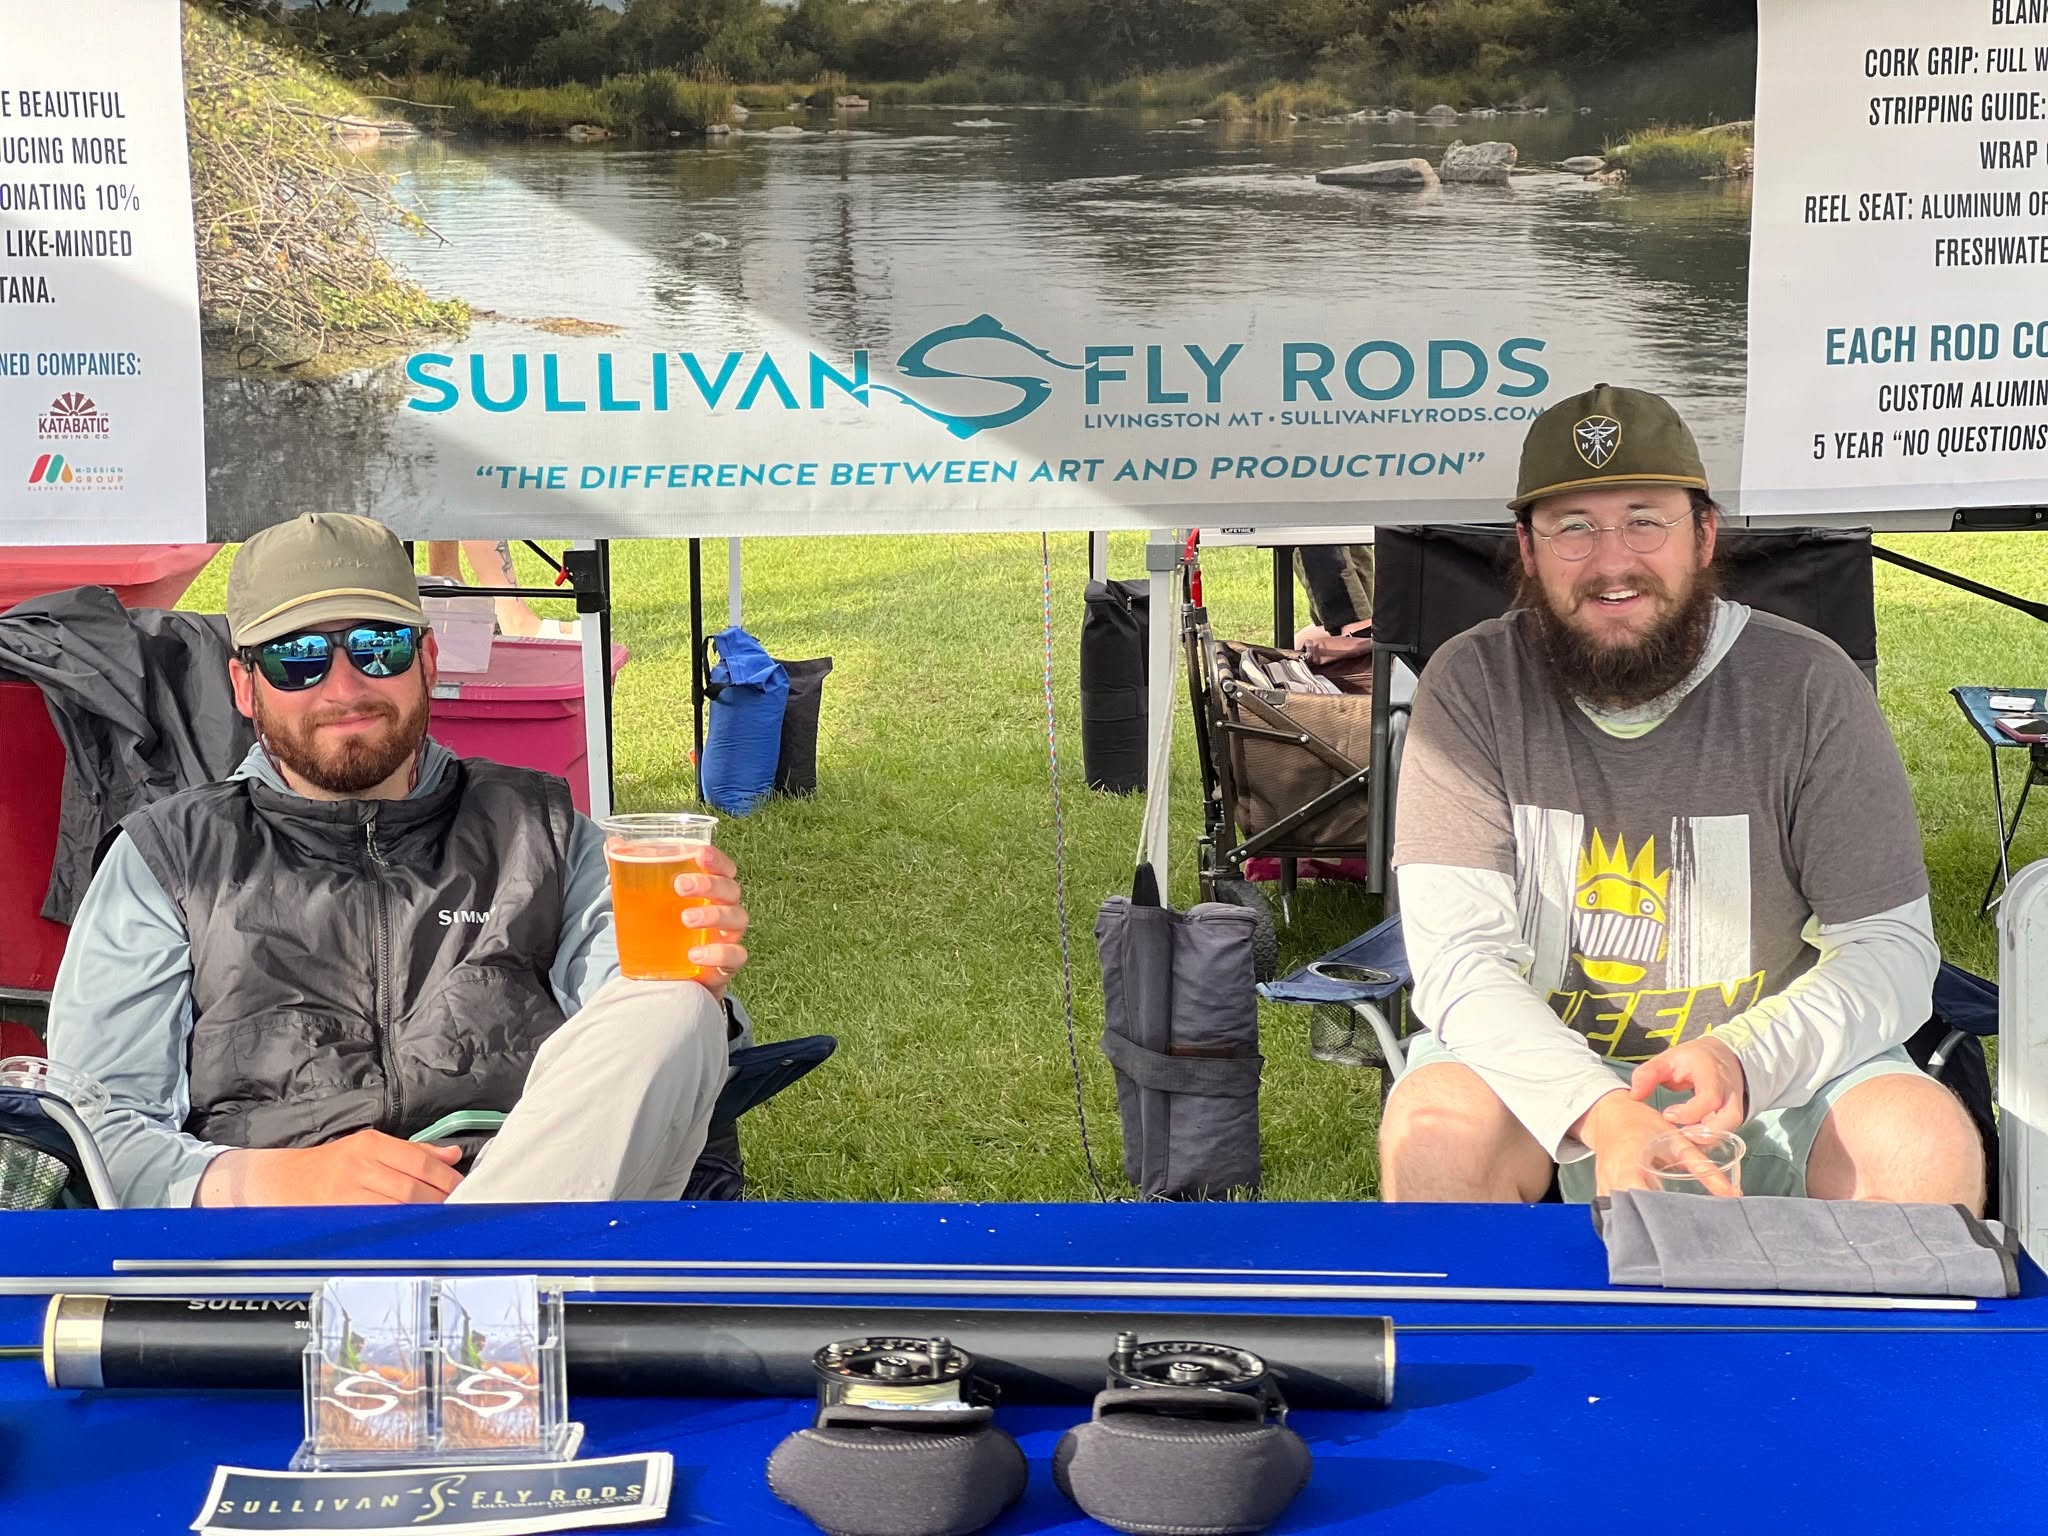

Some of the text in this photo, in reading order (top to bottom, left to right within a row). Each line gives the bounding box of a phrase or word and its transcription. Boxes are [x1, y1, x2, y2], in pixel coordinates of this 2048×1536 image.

[1865, 48, 1919, 78] CORK
[1928, 46, 1979, 75] GRIP:
[1986, 48, 2027, 74] FULL
[19, 90, 126, 118] BEAUTIFUL
[1869, 92, 2046, 126] STRIPPING GUIDE:
[0, 137, 128, 165] UCING MORE
[1979, 140, 2038, 169] WRAP
[0, 183, 140, 211] ONATING 10%
[1804, 195, 1851, 223] REEL
[1859, 192, 1913, 221] SEAT:
[1921, 192, 2021, 220] ALUMINUM
[6, 230, 132, 257] LIKE-MINDED
[1935, 236, 2048, 267] FRESHWATE
[0, 276, 56, 304] TANA.
[1826, 320, 2048, 365] EACH ROD CO
[37, 352, 141, 376] COMPANIES:
[405, 349, 869, 413] SULLIVAN
[1083, 343, 1244, 405] FLY
[1282, 337, 1550, 402] RODS
[1879, 379, 2048, 412] CUSTOM ALUMIN
[38, 417, 110, 433] KATABATIC
[1084, 406, 1545, 429] LIVINGSTON MT SULLIVANFLYRODS.COM
[1813, 433, 1826, 460] 5
[1835, 431, 1884, 459] YEAR
[1937, 424, 2048, 457] QUESTIONS
[579, 463, 818, 489] DIFFERENCE
[830, 460, 1017, 486] BETWEEN
[1028, 459, 1105, 483] ART
[1112, 457, 1198, 482] AND
[187, 1299, 313, 1311] SULLIVA
[217, 1494, 400, 1514] SULLIVAN
[471, 1490, 532, 1505] FLY
[550, 1484, 642, 1502] RODS
